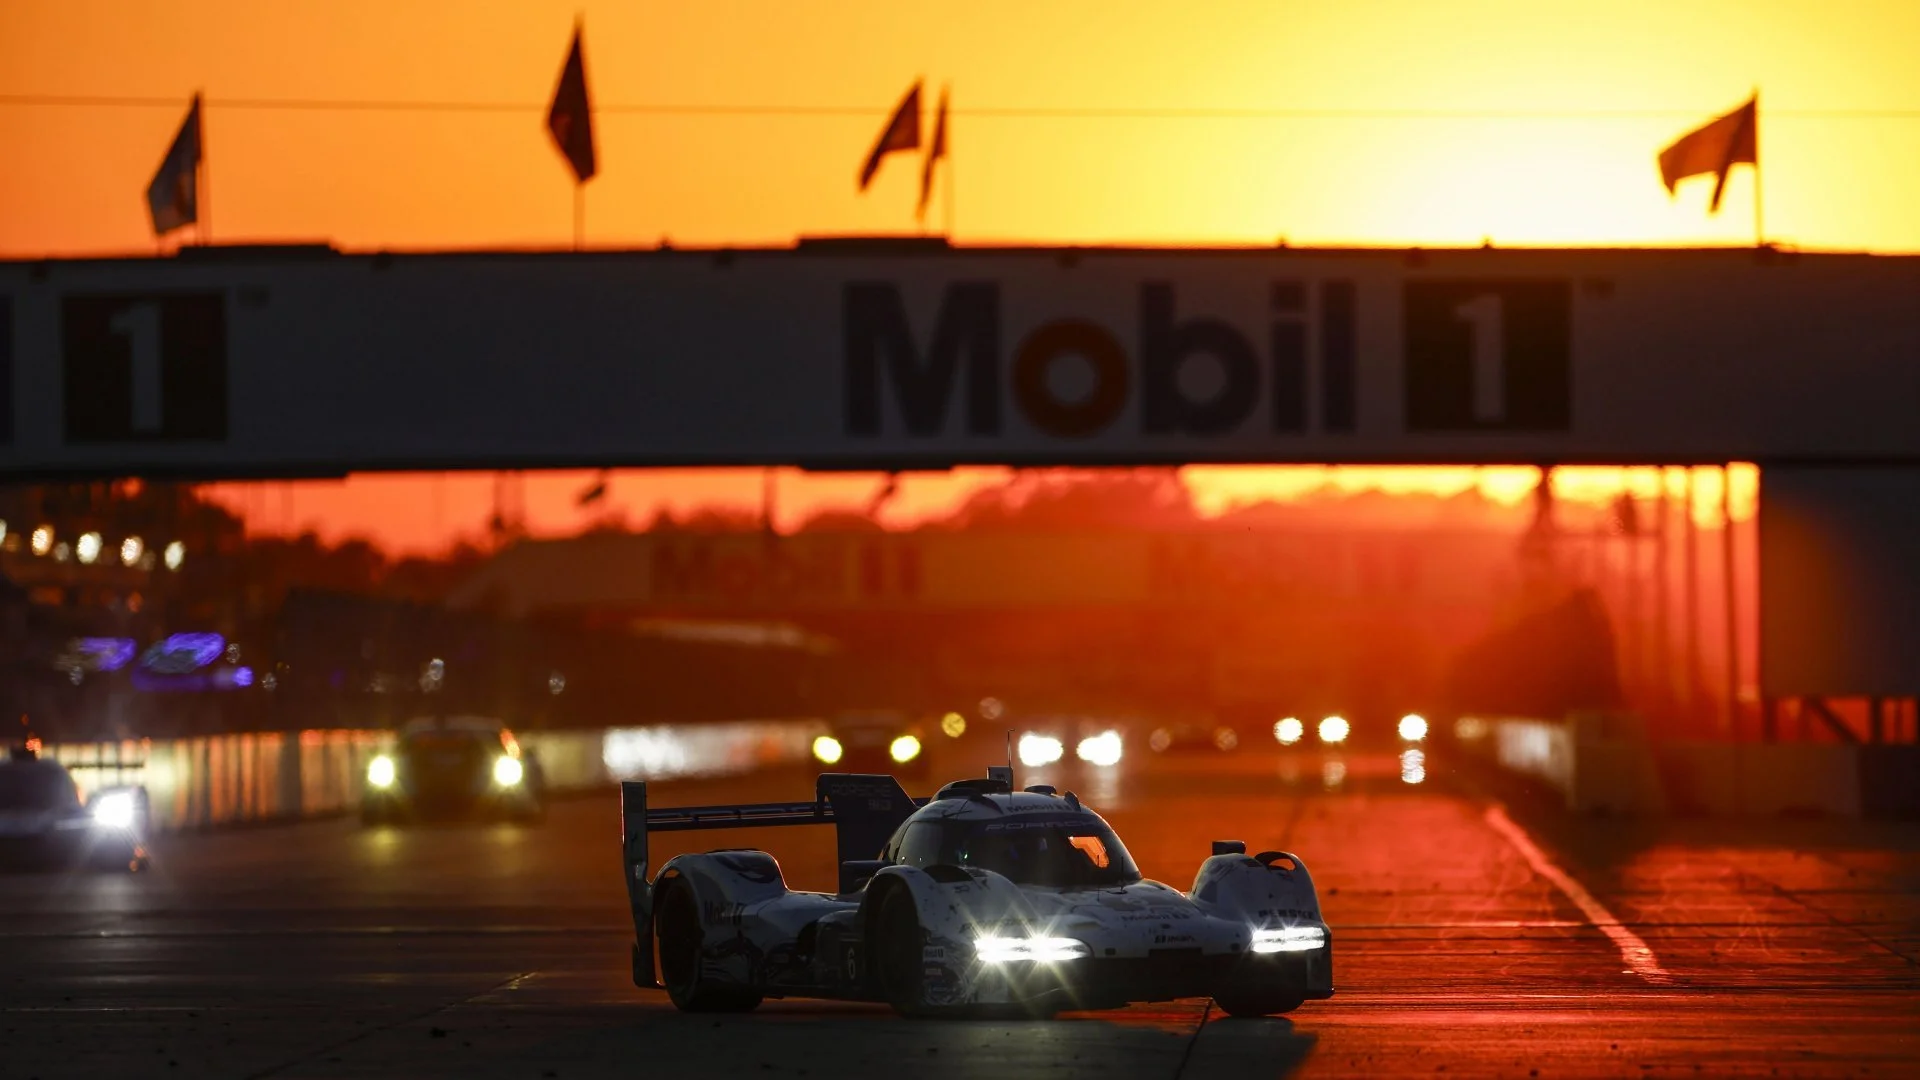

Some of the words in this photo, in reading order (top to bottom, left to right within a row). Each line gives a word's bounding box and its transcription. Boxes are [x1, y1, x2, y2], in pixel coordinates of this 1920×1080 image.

[108, 301, 164, 432] 1
[842, 280, 1356, 438] Mobil
[1454, 292, 1506, 423] 1
[984, 820, 1096, 832] PORSCH
[847, 945, 857, 981] 6
